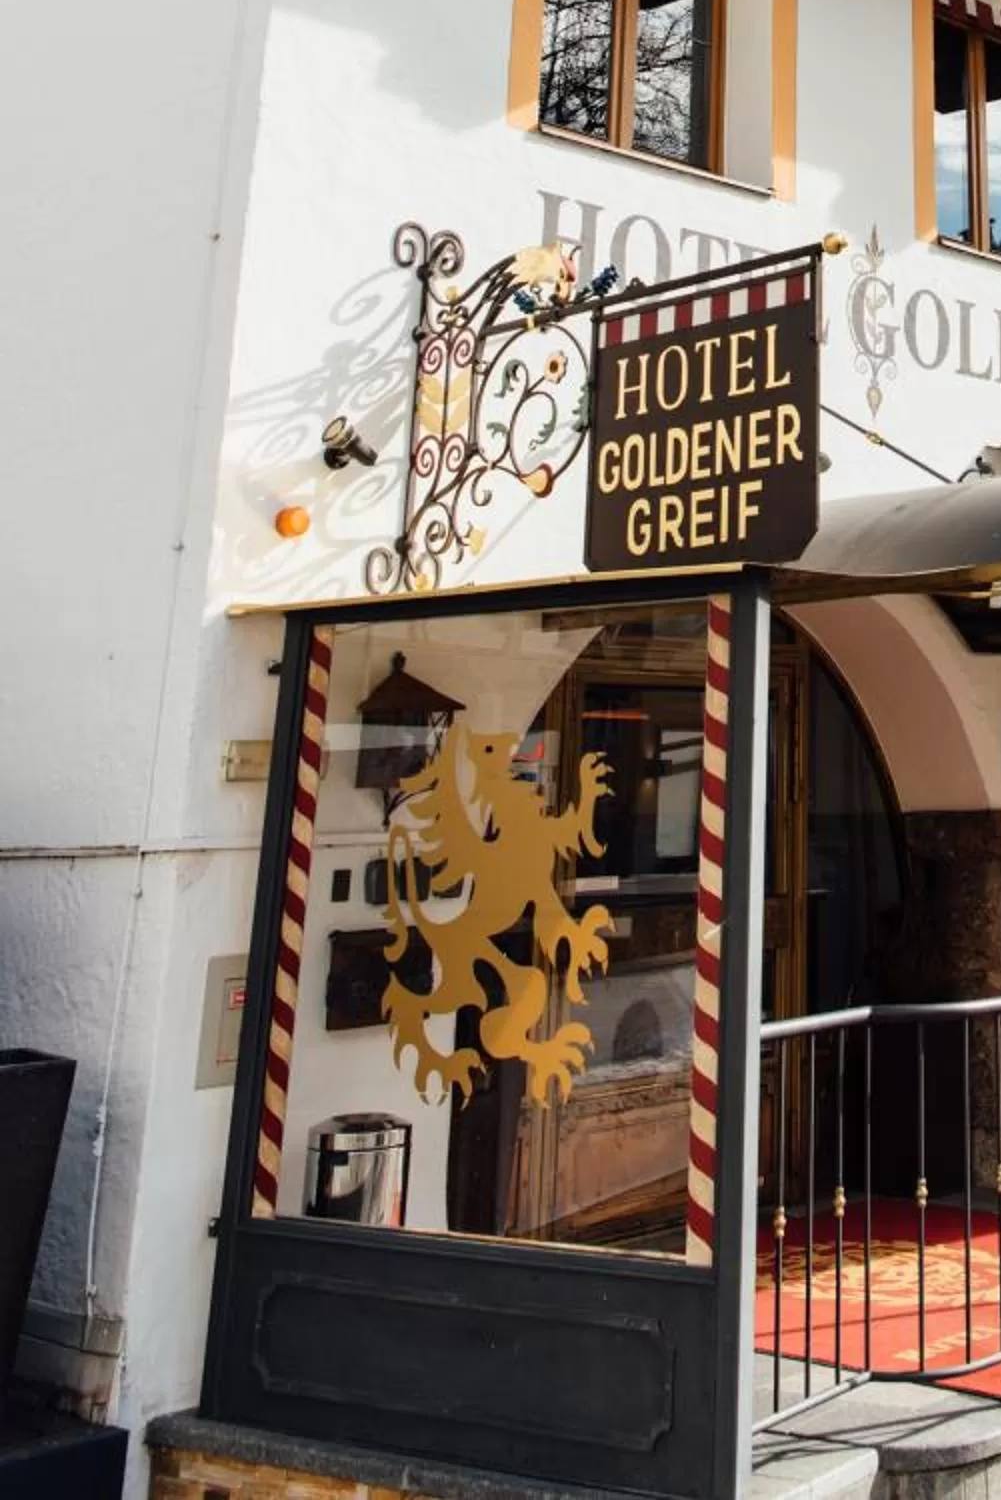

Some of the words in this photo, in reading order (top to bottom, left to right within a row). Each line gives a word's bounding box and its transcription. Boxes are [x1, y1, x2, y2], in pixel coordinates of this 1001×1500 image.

[613, 323, 792, 421] HOTEL
[598, 403, 804, 495] GOLDENER
[626, 479, 764, 556] GREIF
